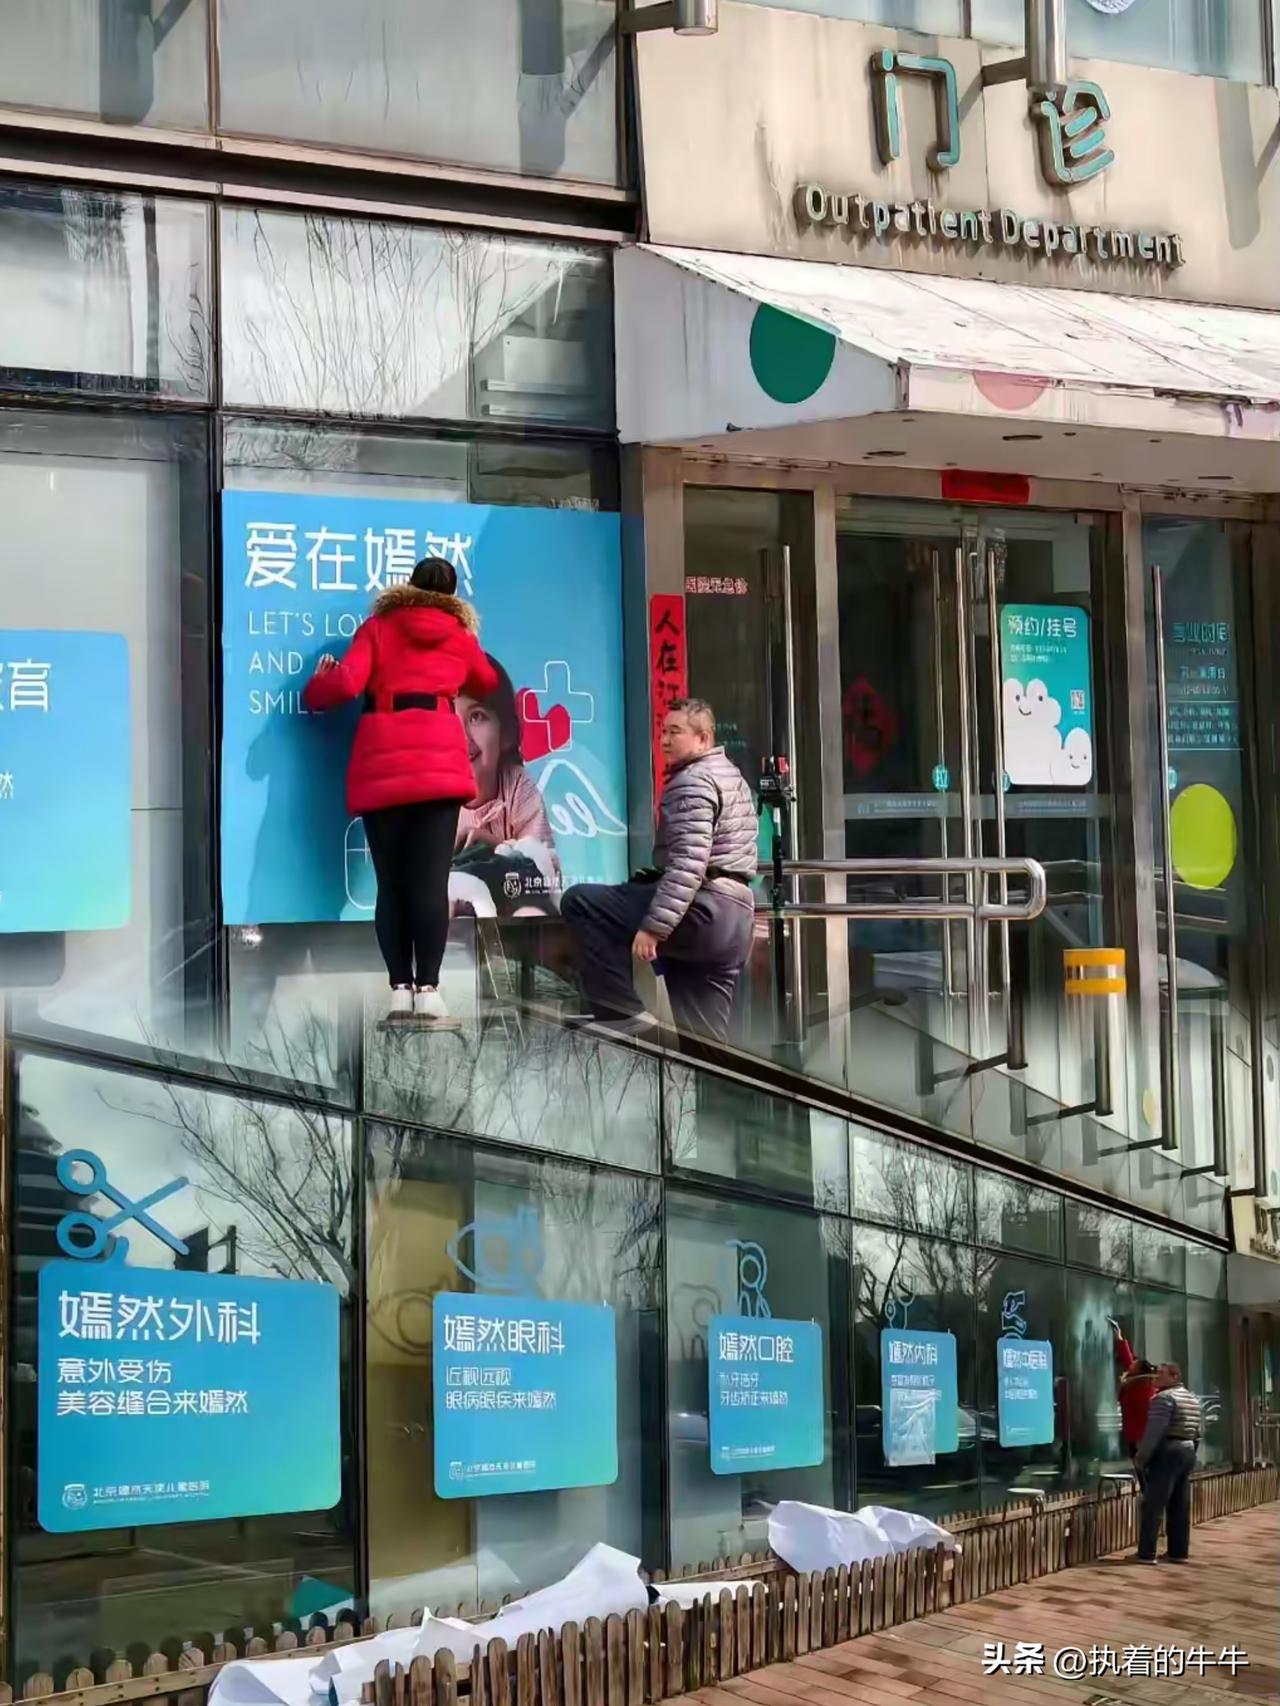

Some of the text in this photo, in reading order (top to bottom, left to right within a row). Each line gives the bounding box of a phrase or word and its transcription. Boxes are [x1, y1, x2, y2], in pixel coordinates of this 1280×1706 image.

[877, 48, 1115, 183] 门诊
[804, 183, 1186, 267] Outpatient Department
[248, 610, 315, 637] LET'S
[1008, 615, 1077, 638] 预约/挂号
[248, 650, 303, 676] AND
[248, 689, 324, 715] SMIL
[57, 1290, 262, 1345] 嫣然外科
[443, 1314, 566, 1355] 嫣然眼科
[719, 1332, 794, 1363] 嫣然口腔
[57, 1358, 172, 1384] 意外受伤
[56, 1389, 248, 1416] 美容缝合来嫣然
[446, 1390, 556, 1409] 眼病眼疾来嫣然
